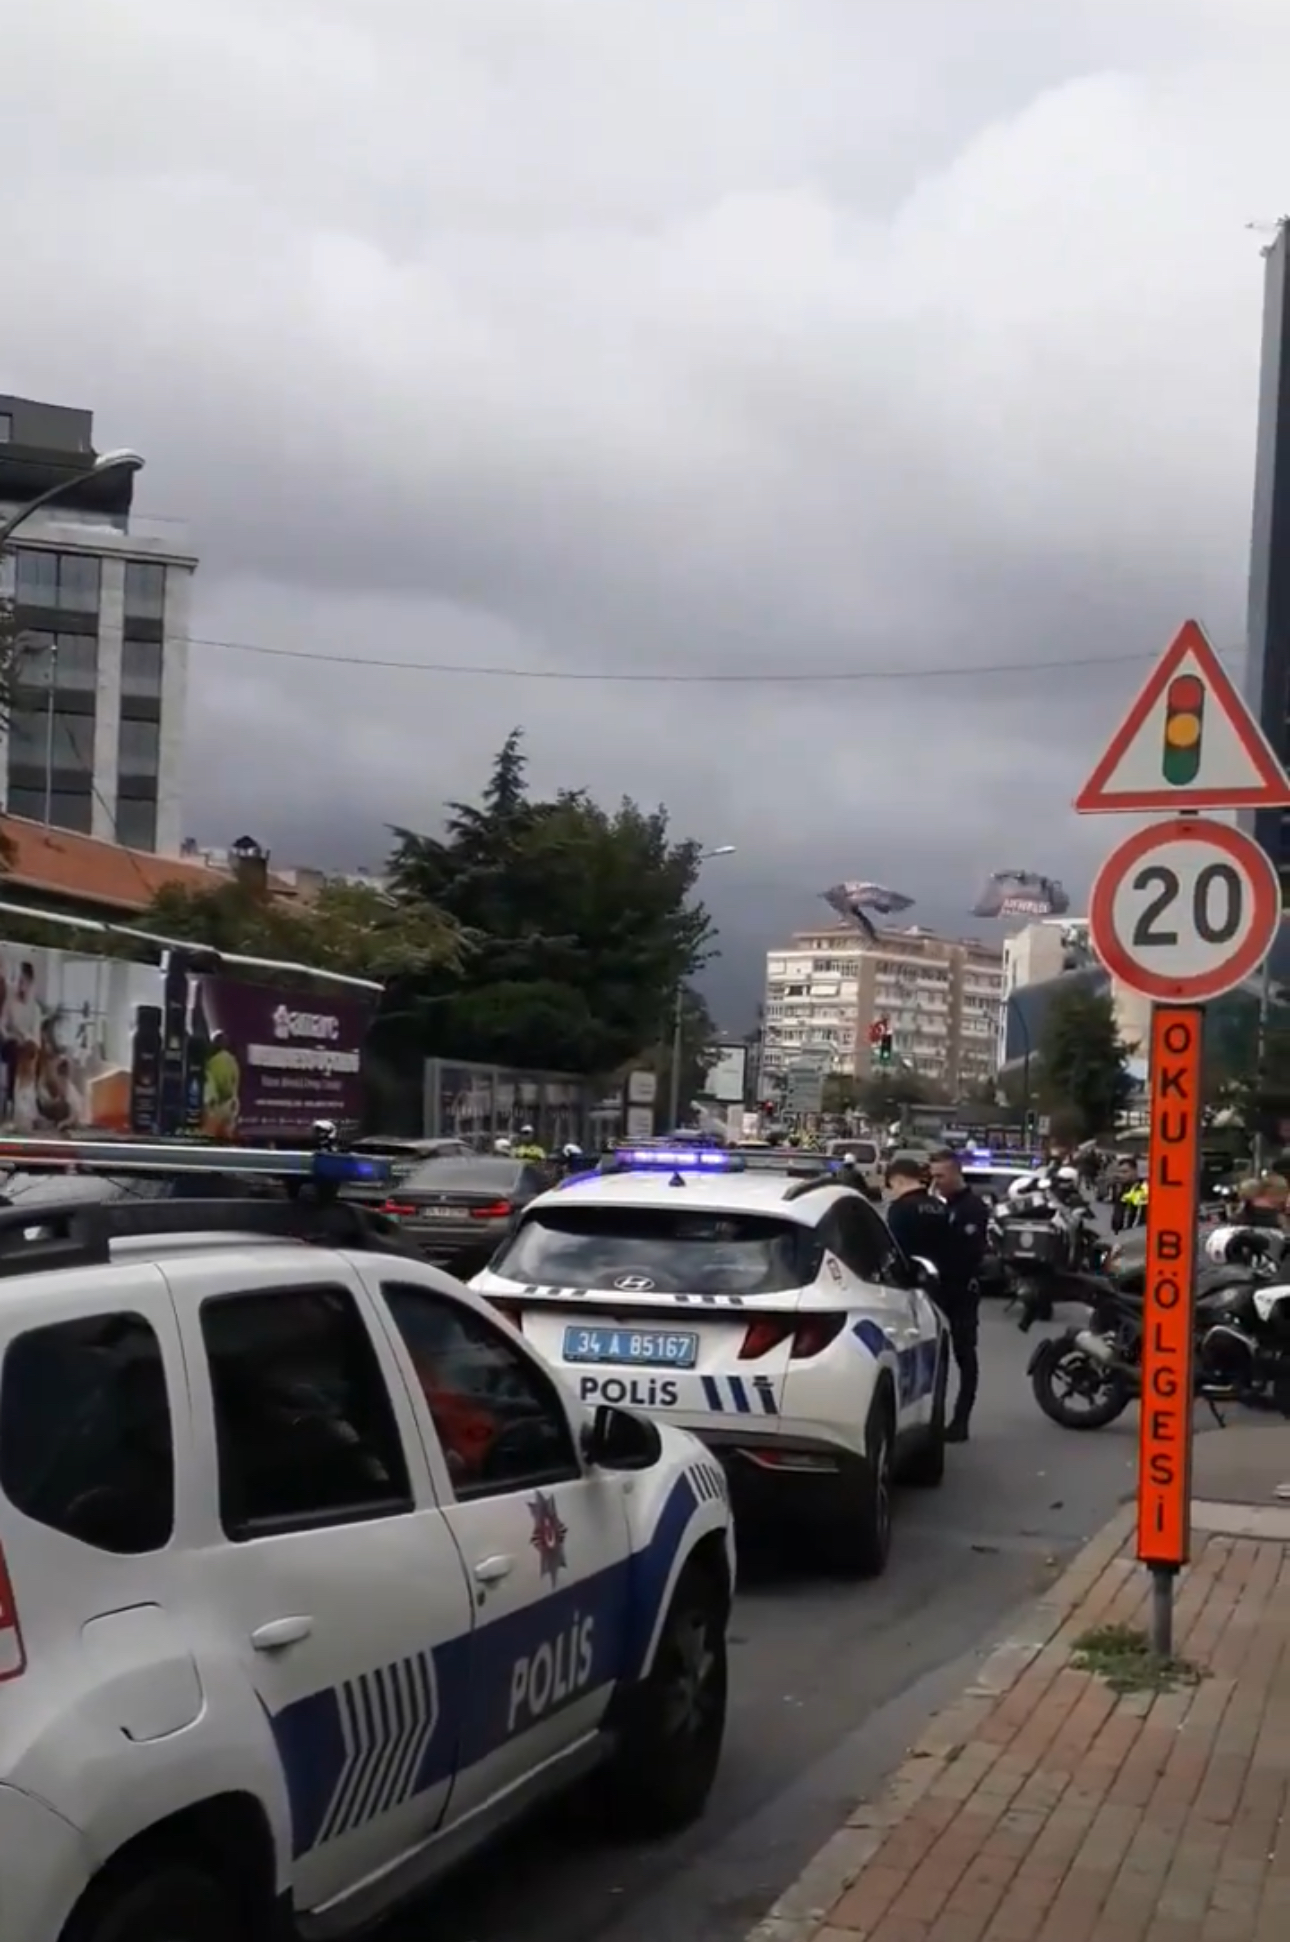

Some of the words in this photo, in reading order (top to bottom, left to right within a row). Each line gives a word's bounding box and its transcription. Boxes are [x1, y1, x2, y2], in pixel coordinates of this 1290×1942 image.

[1132, 862, 1243, 946] 20
[1160, 1022, 1192, 1188] OKUL
[577, 1331, 601, 1353] 34
[608, 1332, 620, 1355] A
[629, 1335, 691, 1359] 85167
[1150, 1230, 1183, 1532] BÖLGESİ
